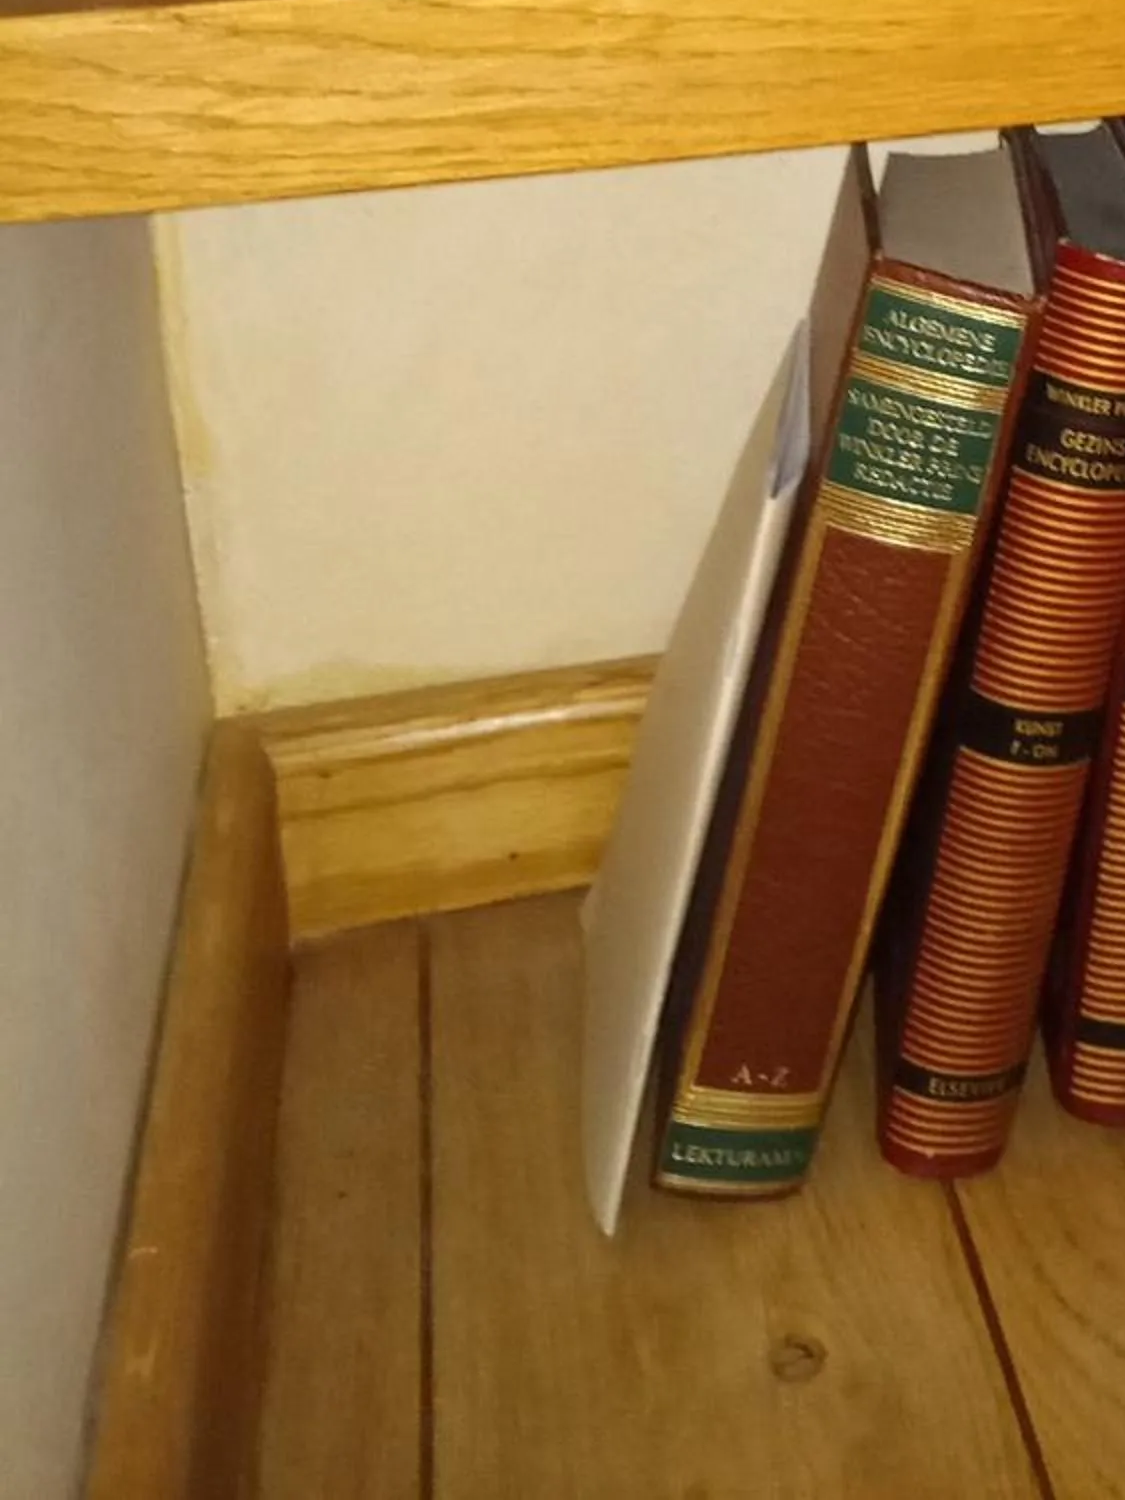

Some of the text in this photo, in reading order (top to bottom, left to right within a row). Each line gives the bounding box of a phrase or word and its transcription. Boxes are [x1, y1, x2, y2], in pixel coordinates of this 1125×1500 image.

[883, 309, 998, 354] ALGEMENE
[863, 324, 1010, 380] ENCYCLOPEDIE
[1045, 381, 1112, 417] WINKLER
[867, 416, 960, 458] DOOR DE
[1013, 718, 1064, 738] KUNST
[729, 1063, 791, 1089] A-Z
